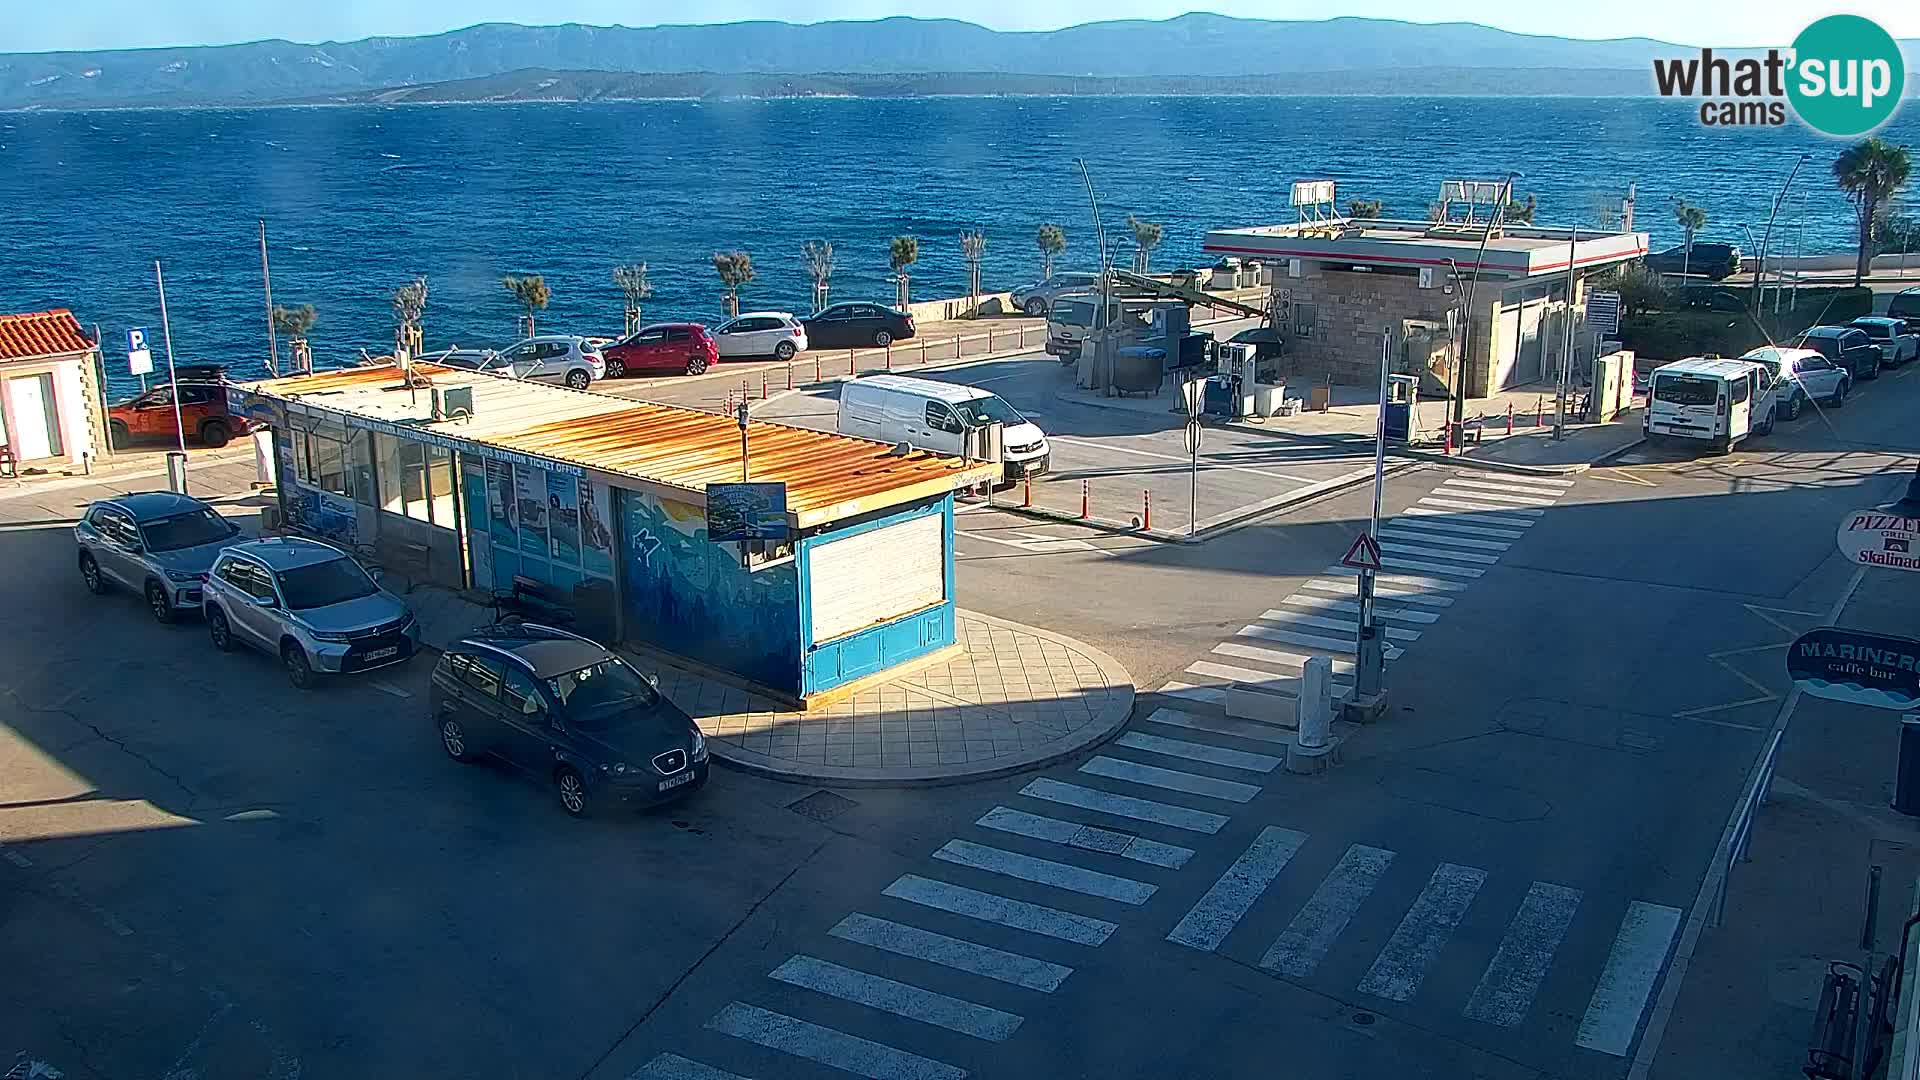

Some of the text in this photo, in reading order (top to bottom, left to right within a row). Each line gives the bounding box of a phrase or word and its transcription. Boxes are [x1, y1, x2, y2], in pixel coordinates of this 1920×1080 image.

[130, 330, 144, 350] P
[480, 446, 493, 457] BUS
[495, 449, 527, 464] STATION
[530, 458, 554, 471] TICKET
[556, 464, 582, 477] OFFICE
[1848, 515, 1920, 534] PIZZE
[1881, 531, 1917, 540] GRILL
[1828, 663, 1896, 680] caffe bar
